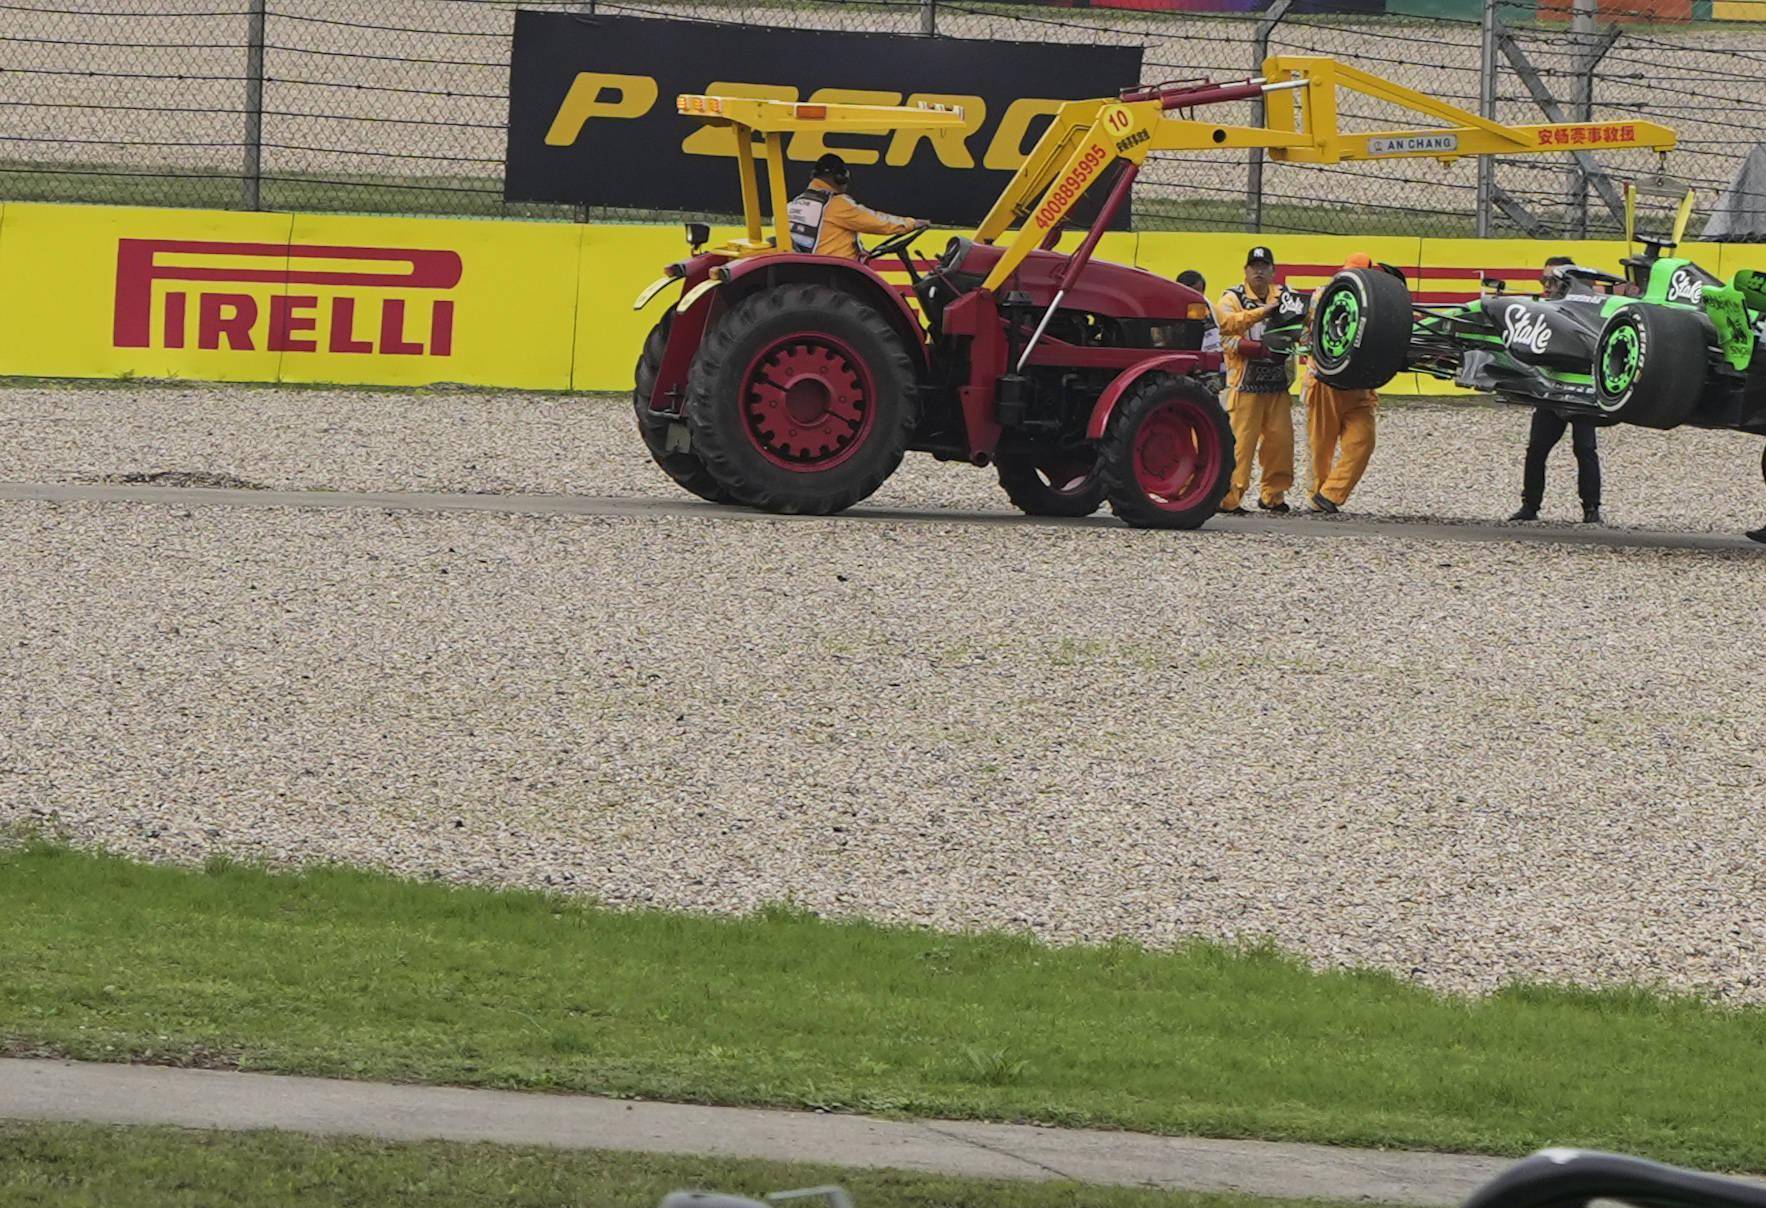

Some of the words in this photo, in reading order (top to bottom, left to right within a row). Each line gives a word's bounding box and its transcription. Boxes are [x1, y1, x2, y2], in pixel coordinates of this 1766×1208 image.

[545, 71, 658, 147] P
[1108, 110, 1129, 132] 10
[1387, 138, 1404, 150] AN
[1408, 137, 1451, 150] CHANG
[1034, 143, 1107, 230] 4008895995
[113, 237, 463, 357] PIRELLI
[1668, 269, 1703, 304] Stake
[1502, 303, 1553, 354] Stake
